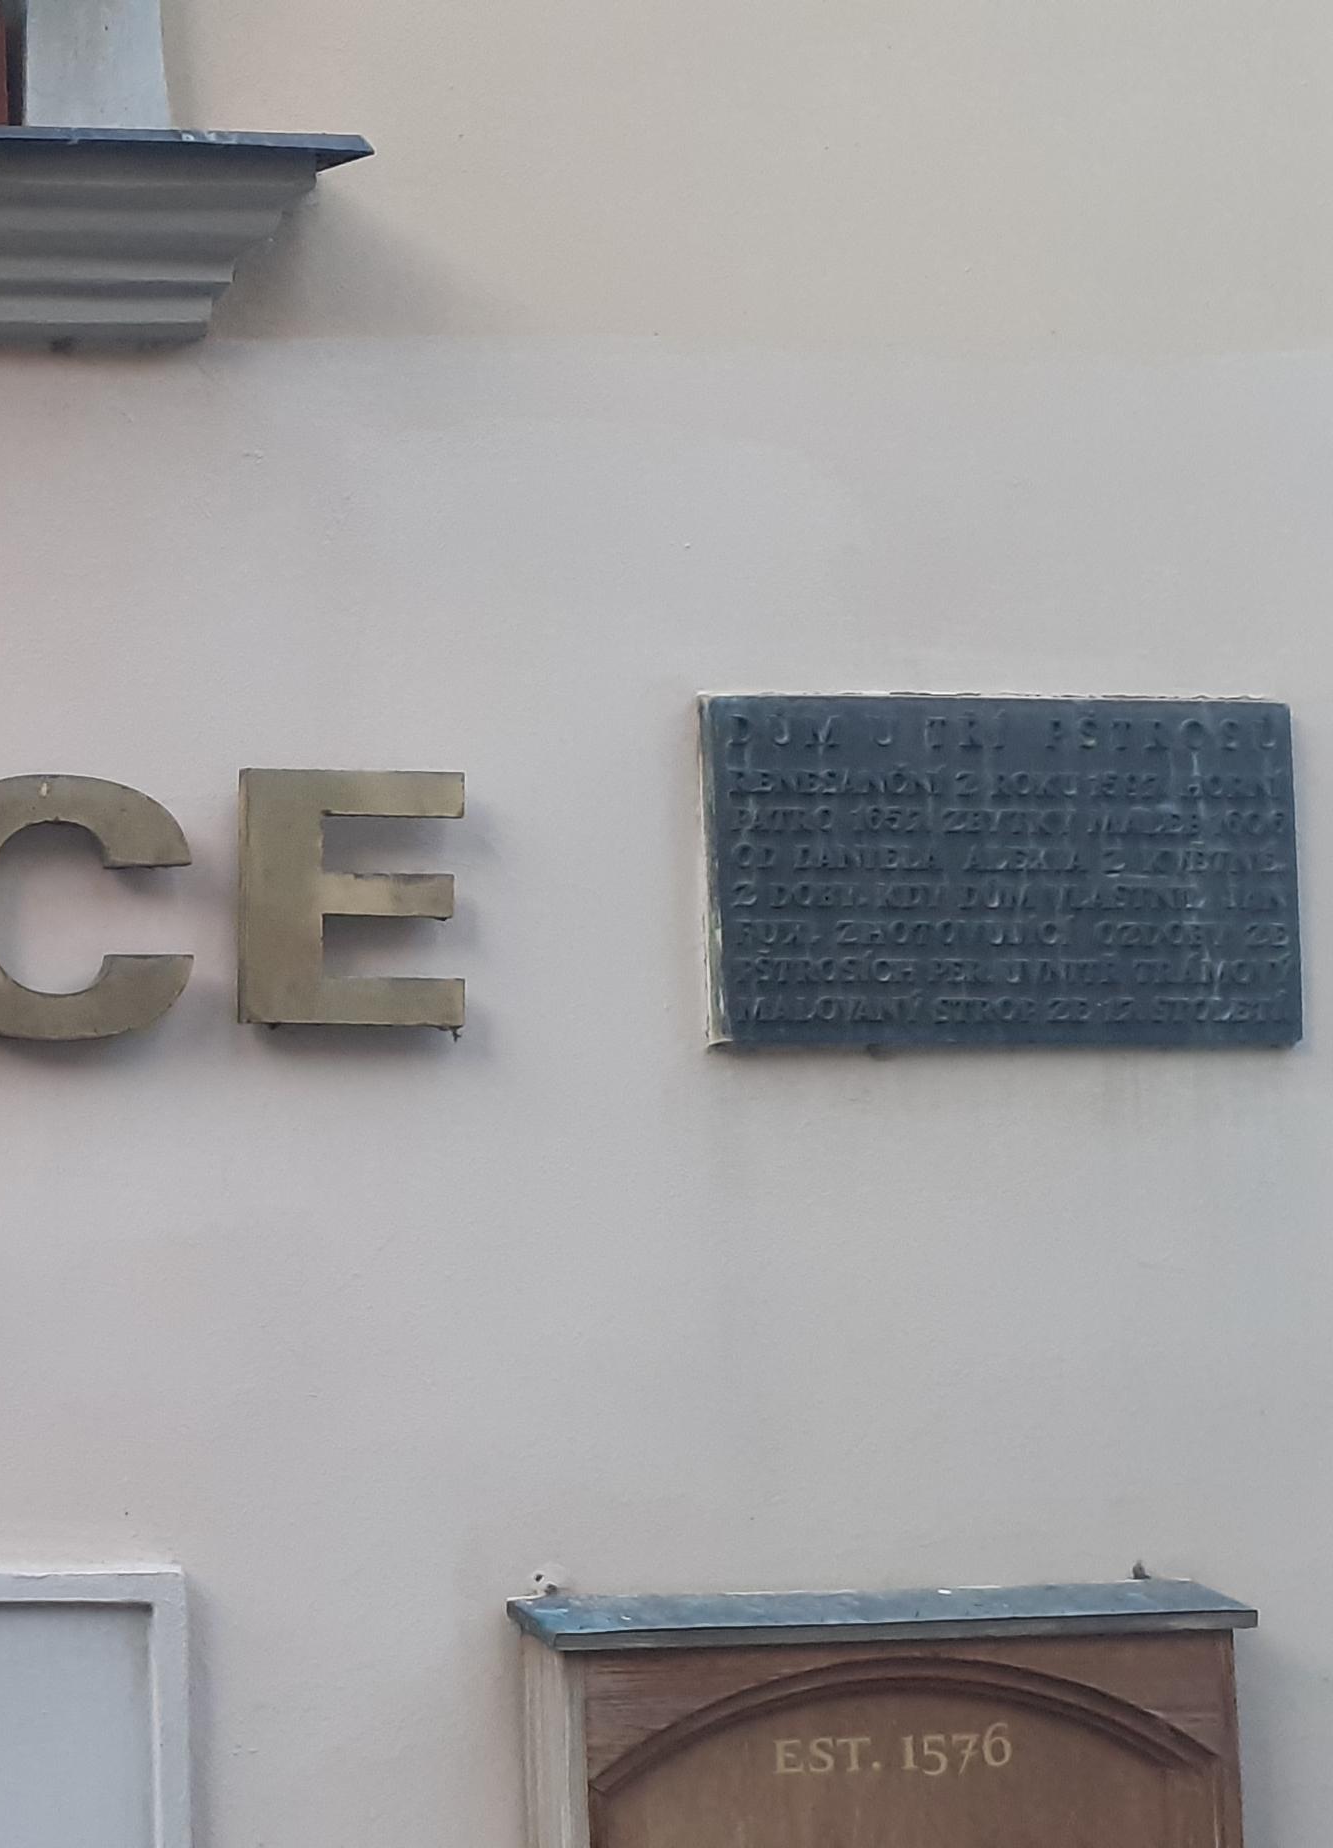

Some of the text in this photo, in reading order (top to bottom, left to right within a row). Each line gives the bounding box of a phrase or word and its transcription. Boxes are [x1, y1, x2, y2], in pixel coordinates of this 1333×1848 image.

[865, 714, 894, 748] U
[773, 1722, 1013, 1777] EST. 1576
